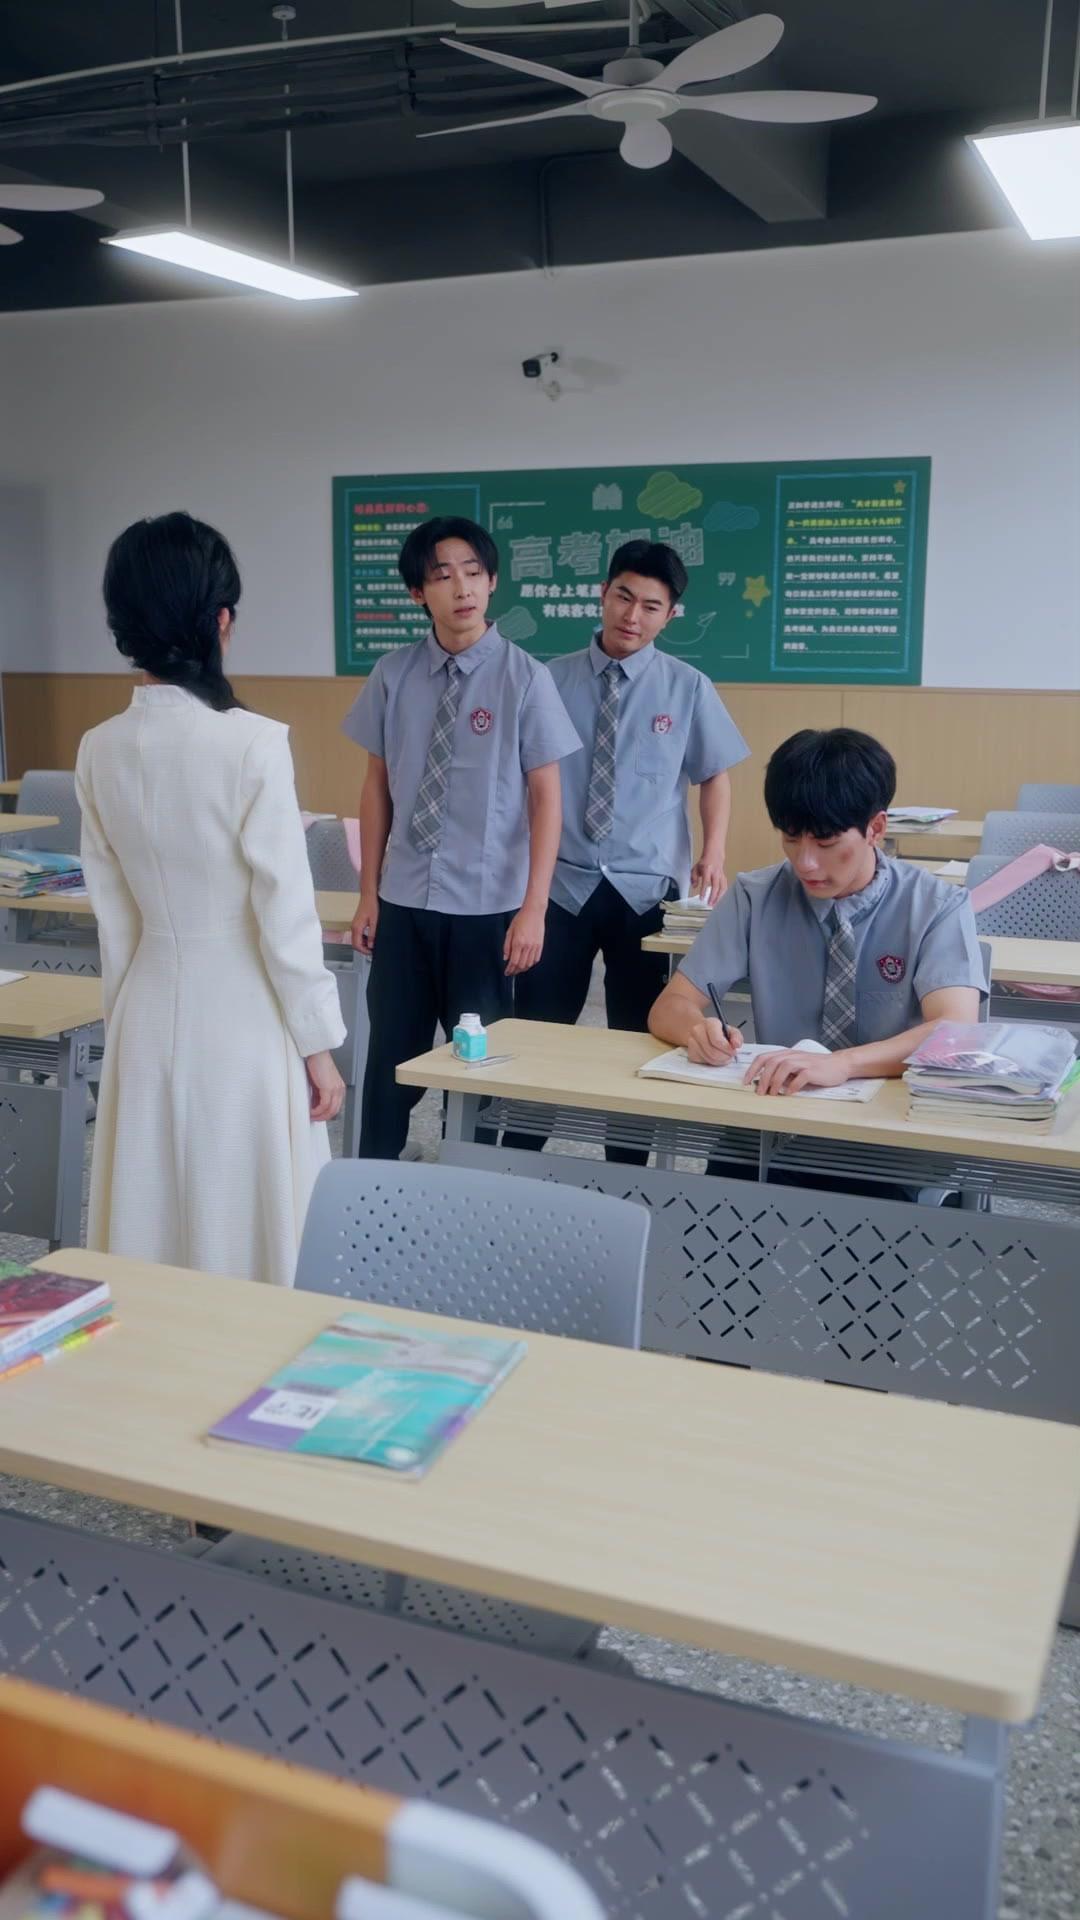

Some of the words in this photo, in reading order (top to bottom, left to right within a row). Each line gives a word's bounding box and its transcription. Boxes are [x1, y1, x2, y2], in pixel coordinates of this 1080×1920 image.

[788, 517, 901, 527] 一的上百分之九十九的汗
[543, 604, 603, 618] 有侠客收
